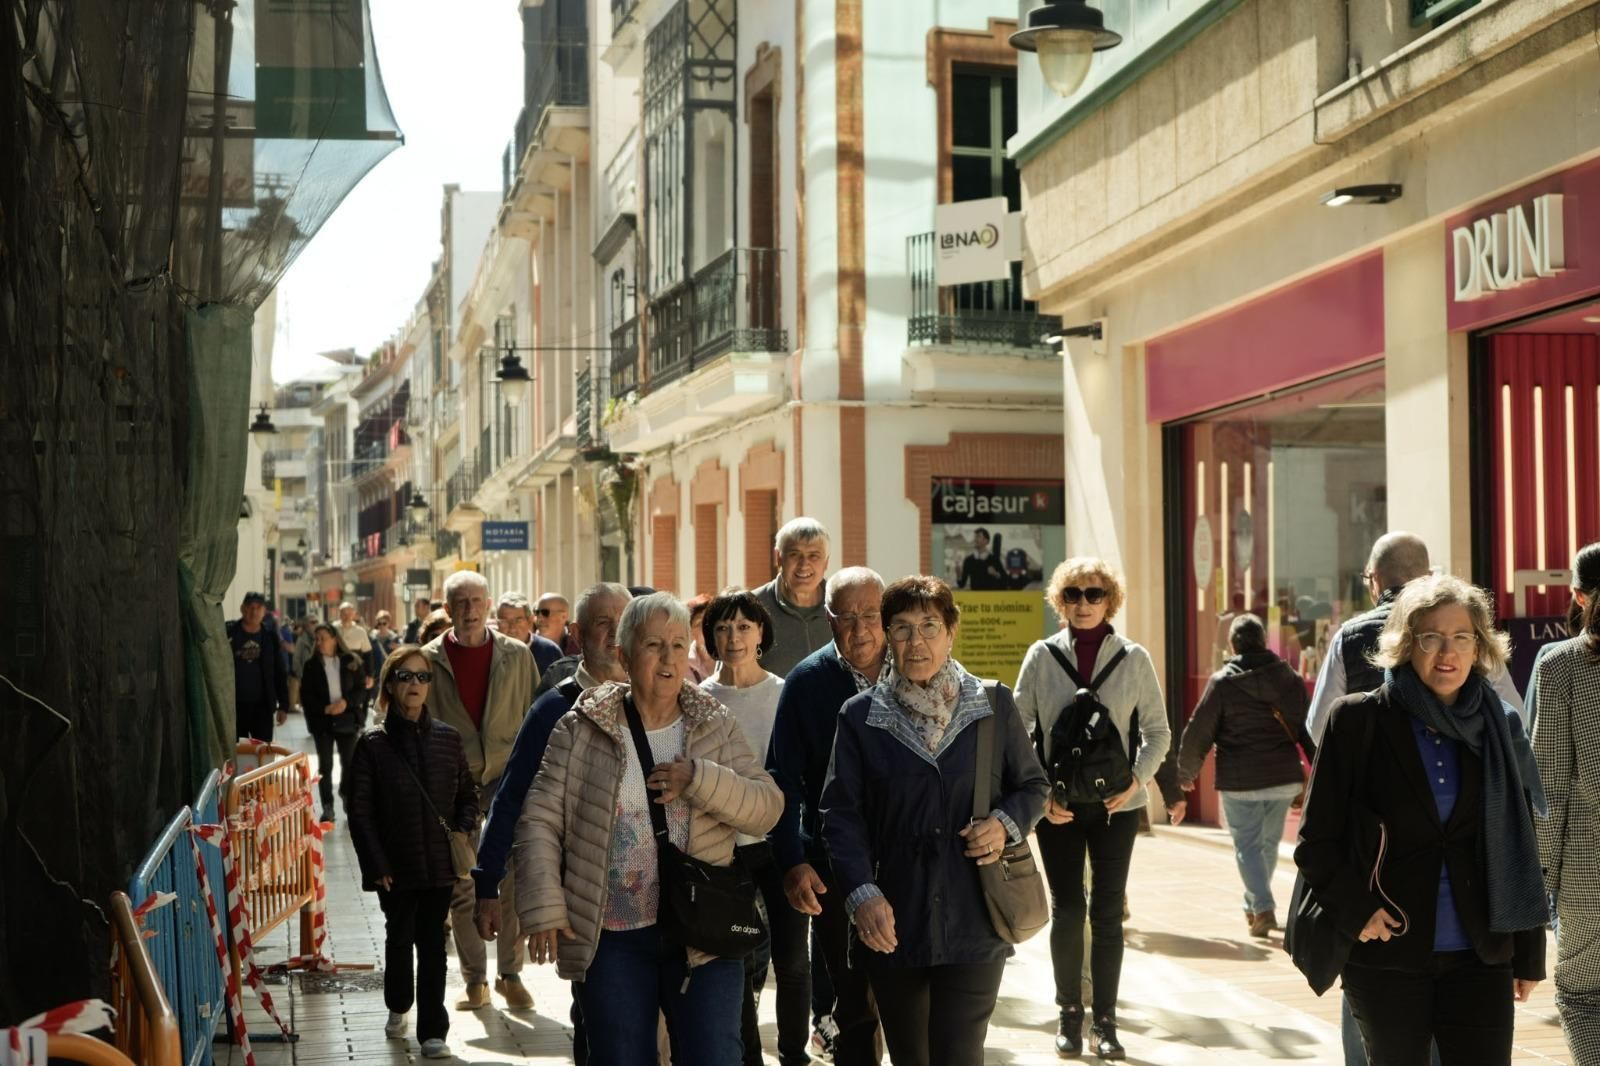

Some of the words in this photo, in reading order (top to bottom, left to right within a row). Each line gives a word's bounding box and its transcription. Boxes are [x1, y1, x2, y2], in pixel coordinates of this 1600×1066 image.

[1453, 194, 1562, 301] DRUNI
[942, 490, 1029, 518] cajasur
[980, 602, 991, 613] tu
